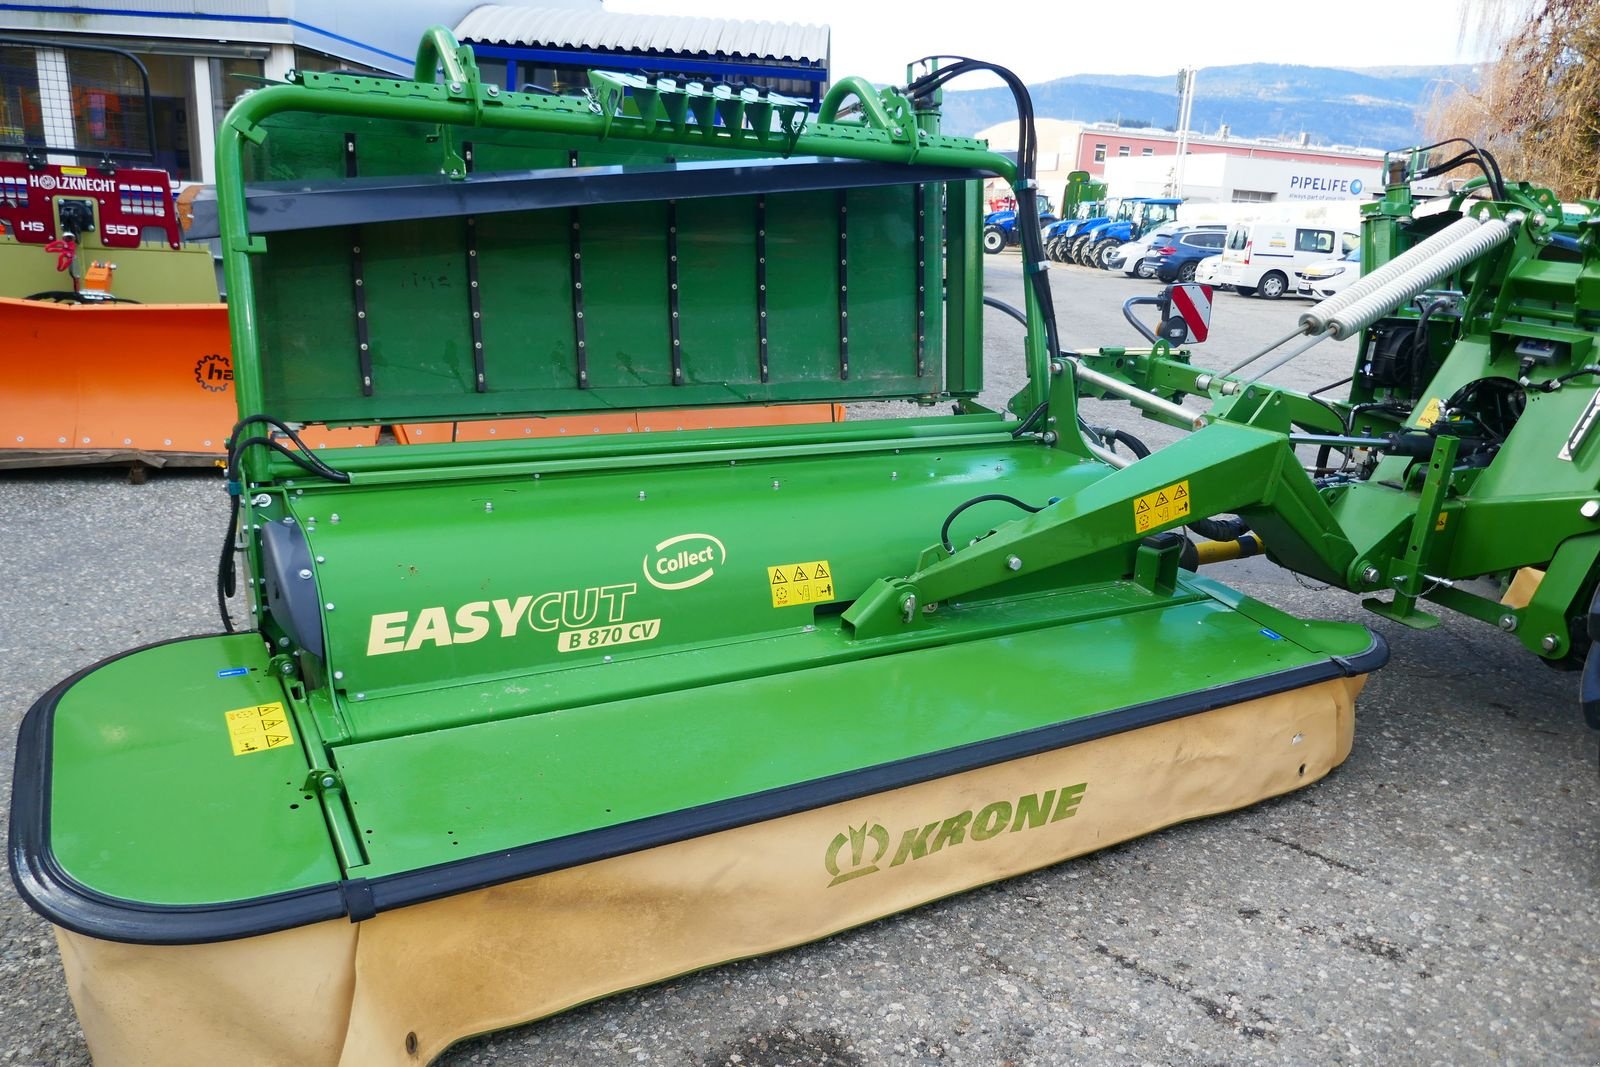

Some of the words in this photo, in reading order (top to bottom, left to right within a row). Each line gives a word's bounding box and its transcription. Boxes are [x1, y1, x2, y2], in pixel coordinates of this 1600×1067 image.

[30, 174, 115, 192] HOLZKNECHT
[1290, 176, 1348, 192] PIPELIFE
[21, 221, 45, 232] HS
[105, 224, 139, 236] 550
[656, 545, 714, 575] Collect
[366, 583, 637, 656] EASYCUT
[569, 633, 581, 649] B
[588, 626, 623, 645] 870
[629, 622, 655, 639] CV
[889, 782, 1088, 867] KRONE
